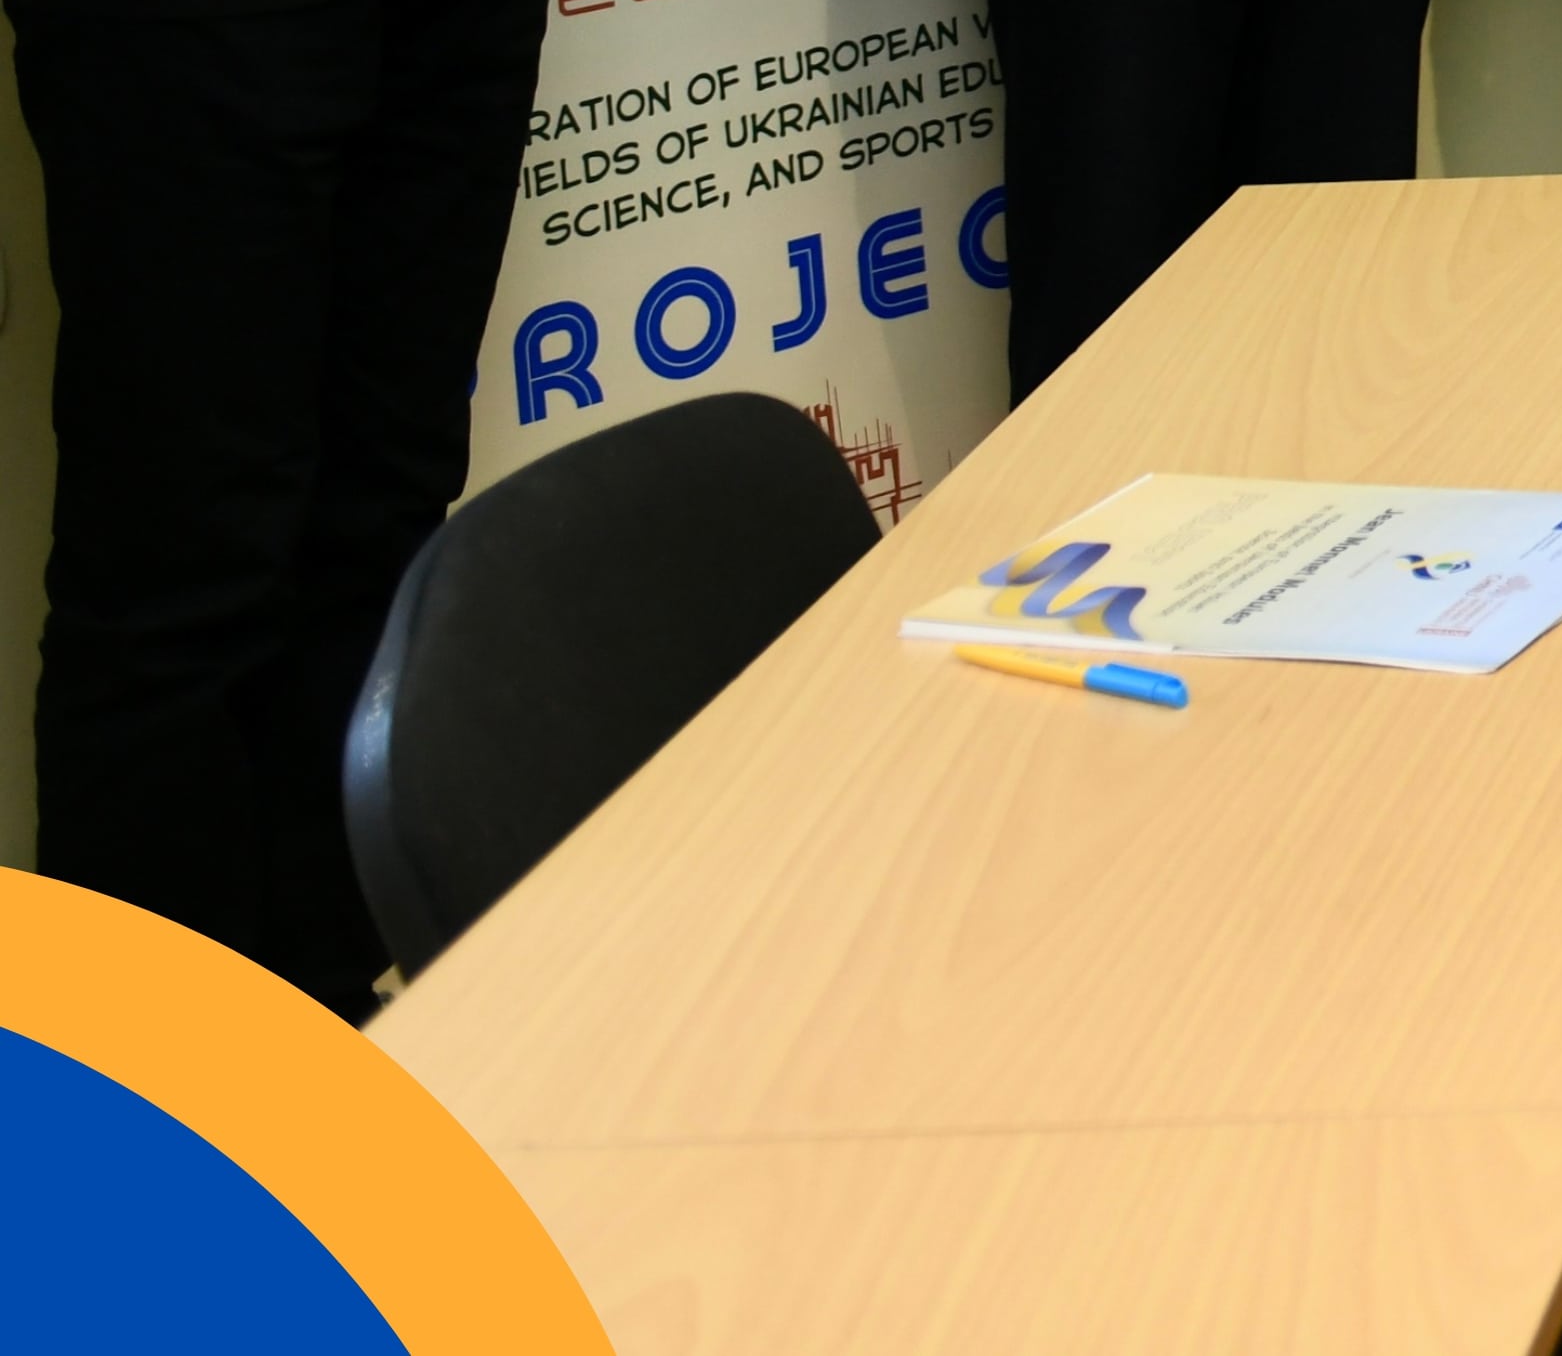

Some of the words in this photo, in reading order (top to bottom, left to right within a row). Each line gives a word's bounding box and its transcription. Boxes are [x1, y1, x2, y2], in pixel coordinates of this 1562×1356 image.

[687, 64, 740, 106] OF
[754, 16, 960, 92] EUROPEAN
[656, 123, 709, 165] OF
[724, 73, 924, 149] UKRAINIAN
[542, 172, 731, 246] SCIENCE,
[746, 149, 824, 197] AND
[838, 107, 995, 171] SPORTS
